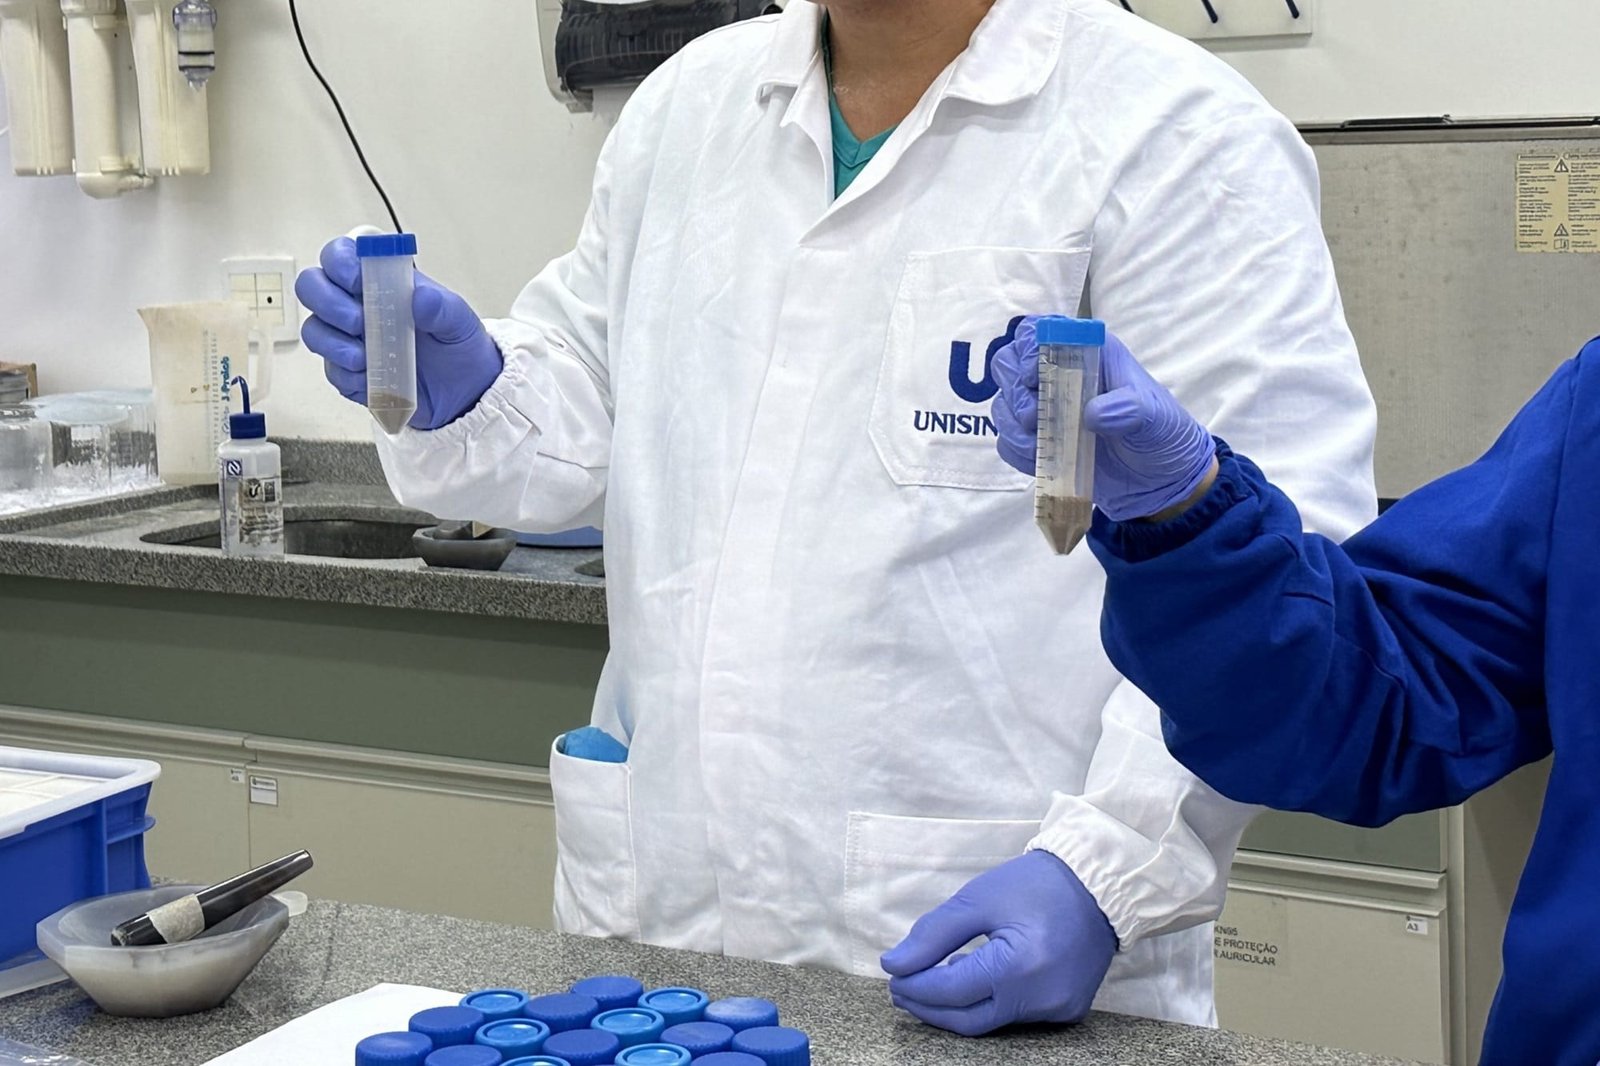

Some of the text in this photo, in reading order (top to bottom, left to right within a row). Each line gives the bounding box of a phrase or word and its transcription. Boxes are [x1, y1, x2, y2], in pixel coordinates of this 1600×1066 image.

[914, 410, 998, 437] UNISIN
[1214, 937, 1222, 946] E
[1220, 950, 1276, 966] AURICULAR
